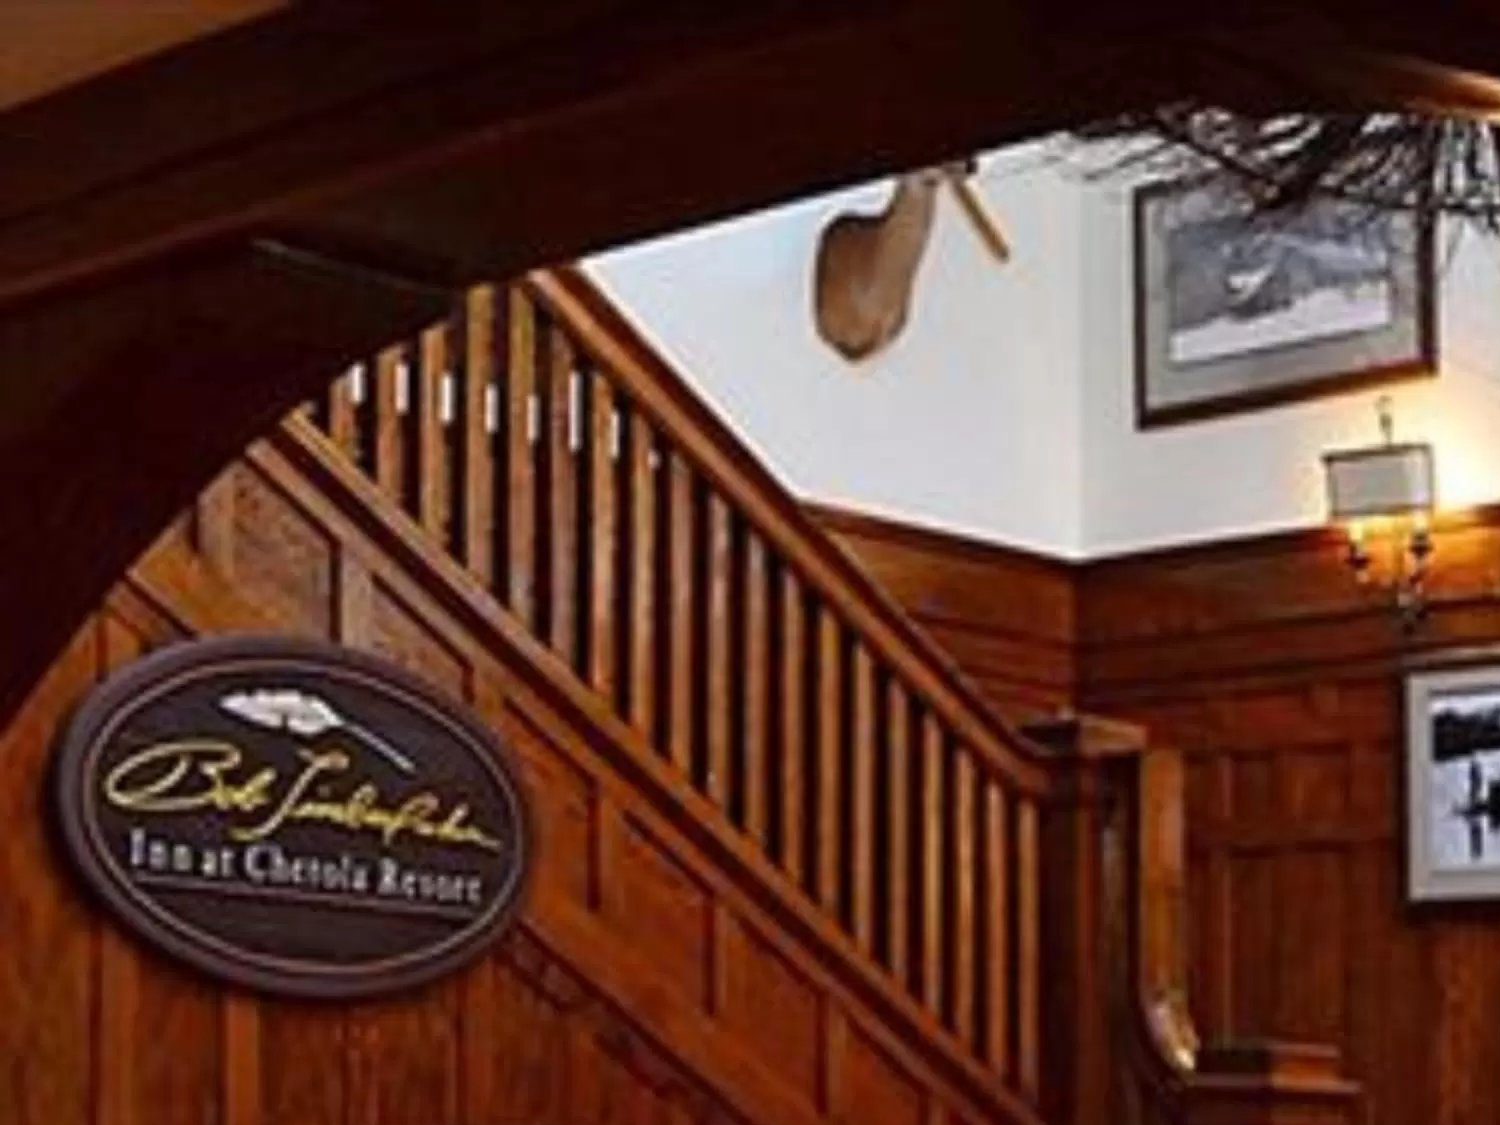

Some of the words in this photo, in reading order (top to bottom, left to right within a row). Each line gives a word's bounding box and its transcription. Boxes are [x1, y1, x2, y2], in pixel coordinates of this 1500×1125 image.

[105, 740, 277, 810] Bob
[129, 826, 193, 872] Inn
[202, 848, 235, 878] at
[377, 856, 482, 903] Resort
